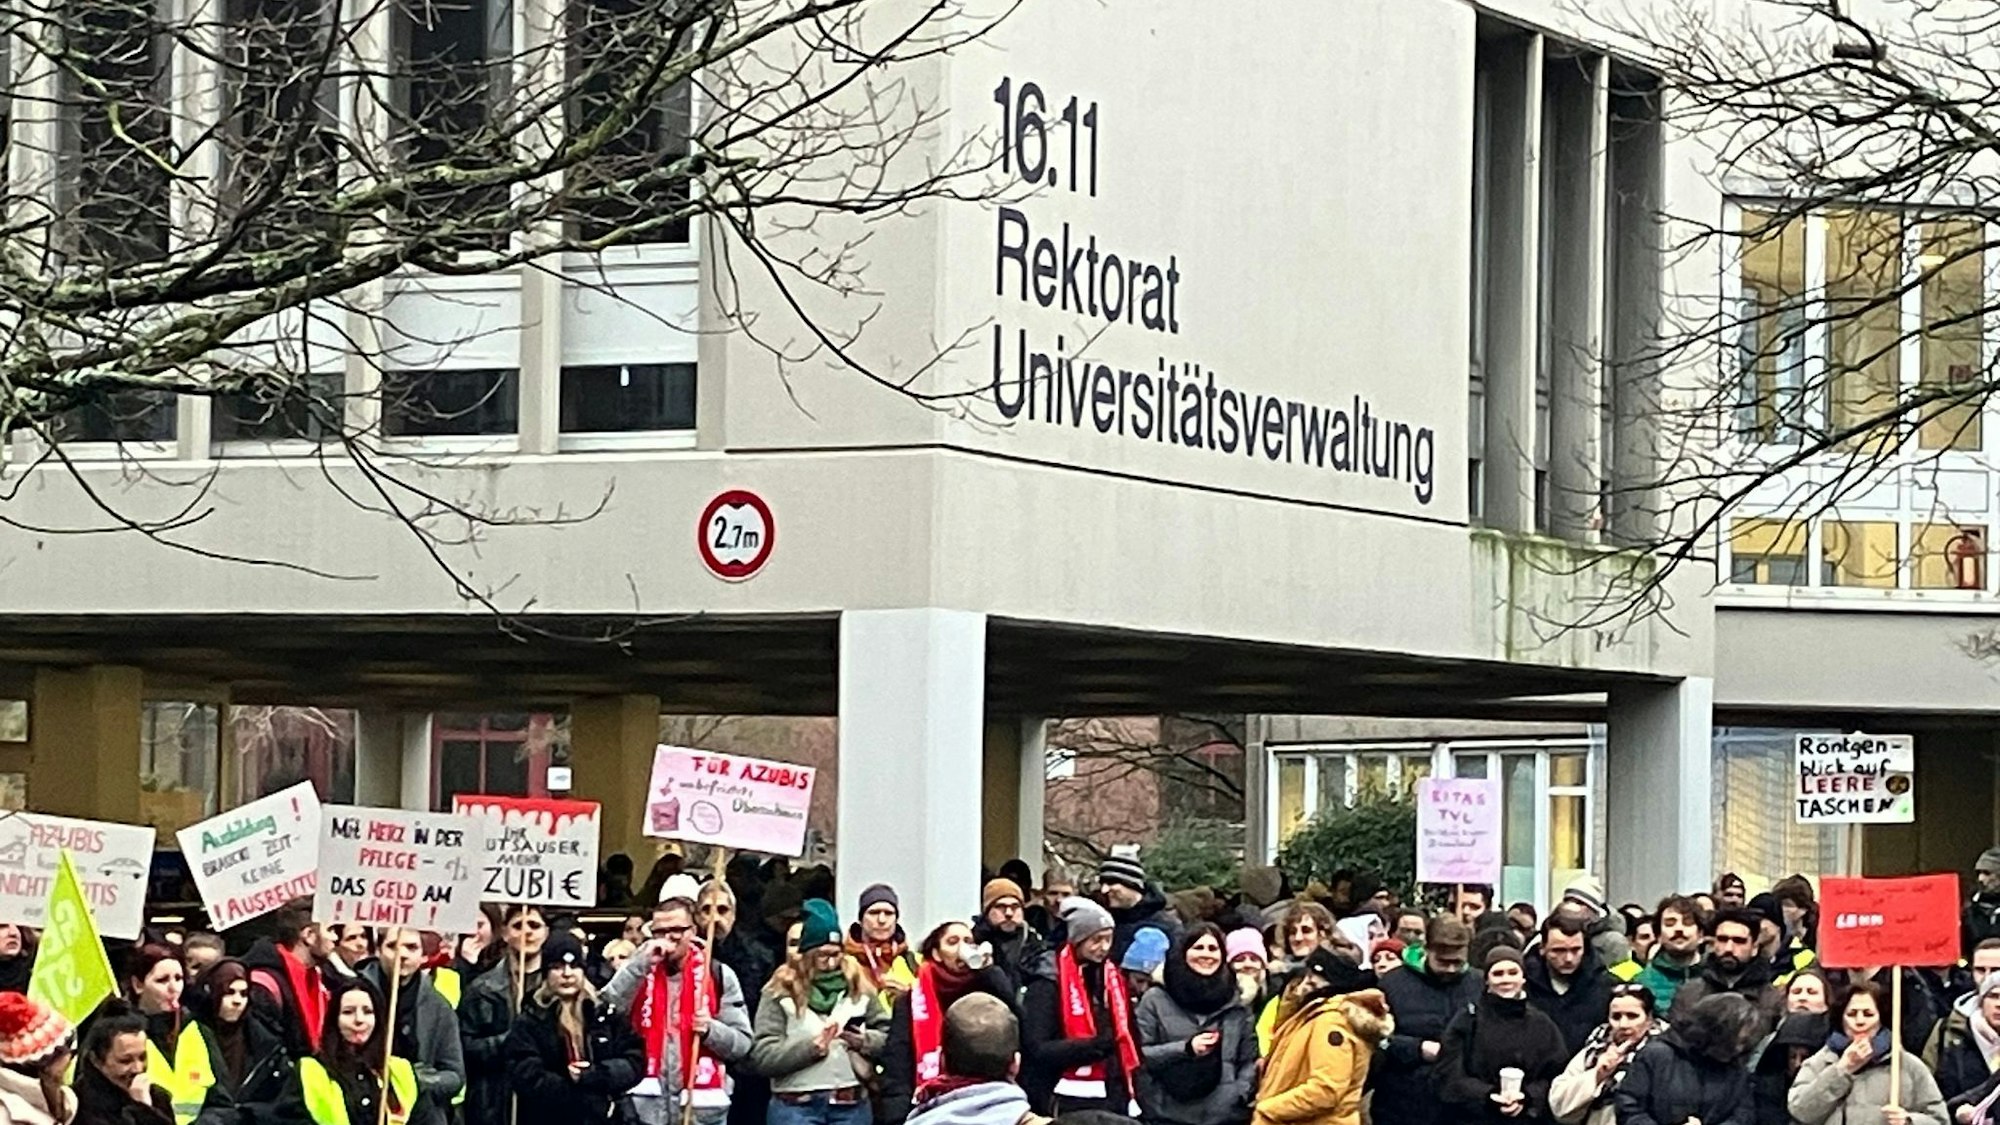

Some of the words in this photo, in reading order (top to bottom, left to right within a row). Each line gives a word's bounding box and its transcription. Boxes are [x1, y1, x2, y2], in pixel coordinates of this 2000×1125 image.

[994, 76, 1098, 197] 16.11
[996, 205, 1180, 334] Rektorat
[994, 324, 1434, 504] Universitätsverwaltung
[1800, 737, 1902, 760] Röntgen-
[691, 755, 731, 777] FÜR
[740, 763, 809, 790] AZUBIS
[1800, 757, 1846, 777] blick
[1853, 758, 1892, 778] auf
[1801, 775, 1875, 794] LEERE
[1438, 808, 1473, 824] TVL
[1796, 797, 1895, 818] TASCHEN
[30, 824, 106, 853] AZUBIS
[368, 820, 406, 843] HERZ
[435, 828, 464, 847] DER
[241, 858, 284, 885] KEINE
[358, 848, 417, 870] PFLEGE
[0, 872, 50, 897] NICHT
[330, 876, 366, 897] DAS
[363, 879, 418, 901] GELD
[422, 885, 453, 903] AM
[561, 870, 583, 900] €
